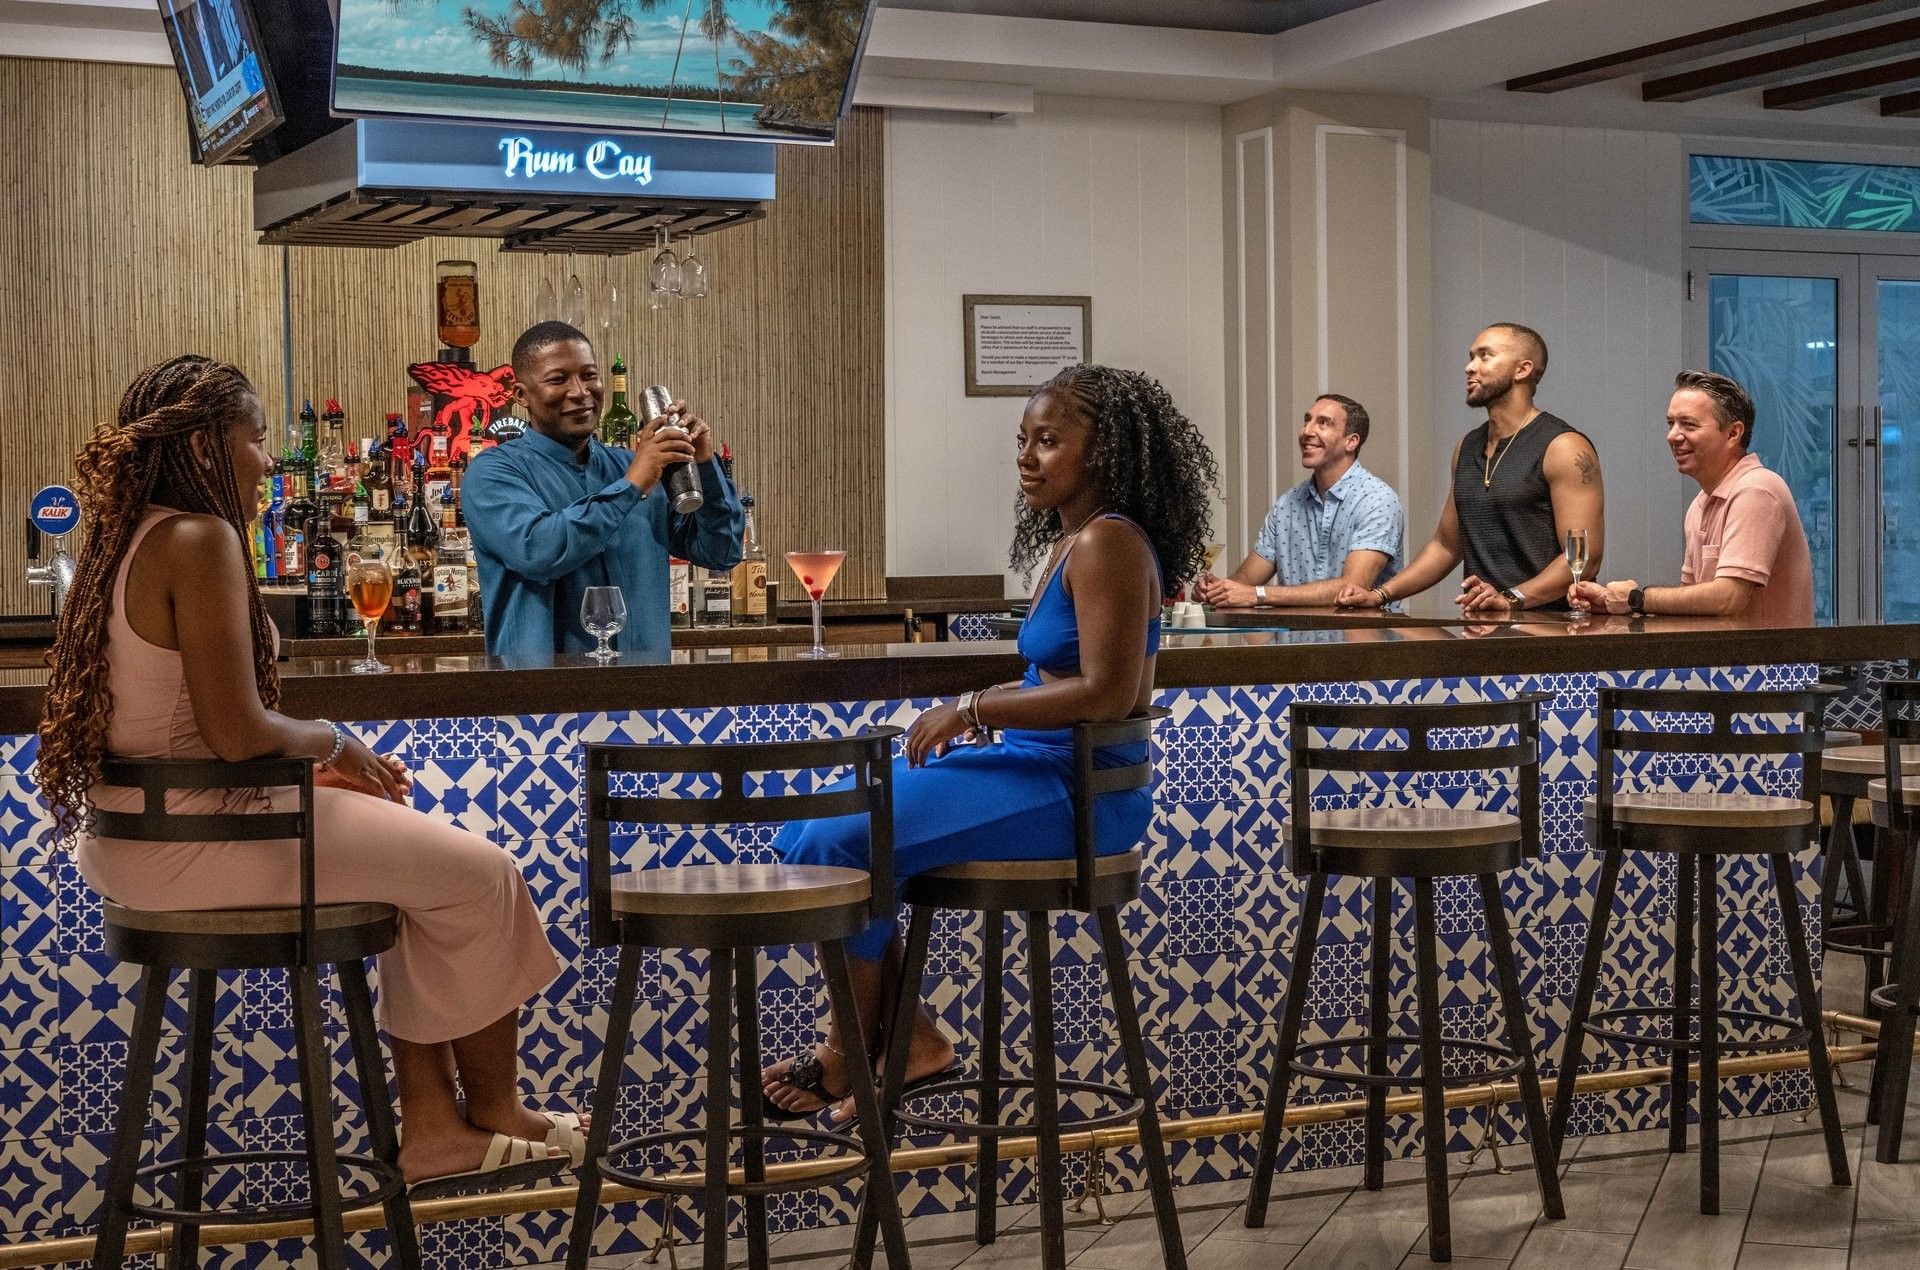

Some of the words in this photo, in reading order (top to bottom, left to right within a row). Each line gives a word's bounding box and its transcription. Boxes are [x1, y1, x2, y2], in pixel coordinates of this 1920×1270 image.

[498, 136, 577, 178] Rum
[585, 140, 653, 186] Cay
[488, 417, 527, 434] FIREBAL
[430, 488, 442, 498] JIM
[42, 508, 68, 517] KALIK
